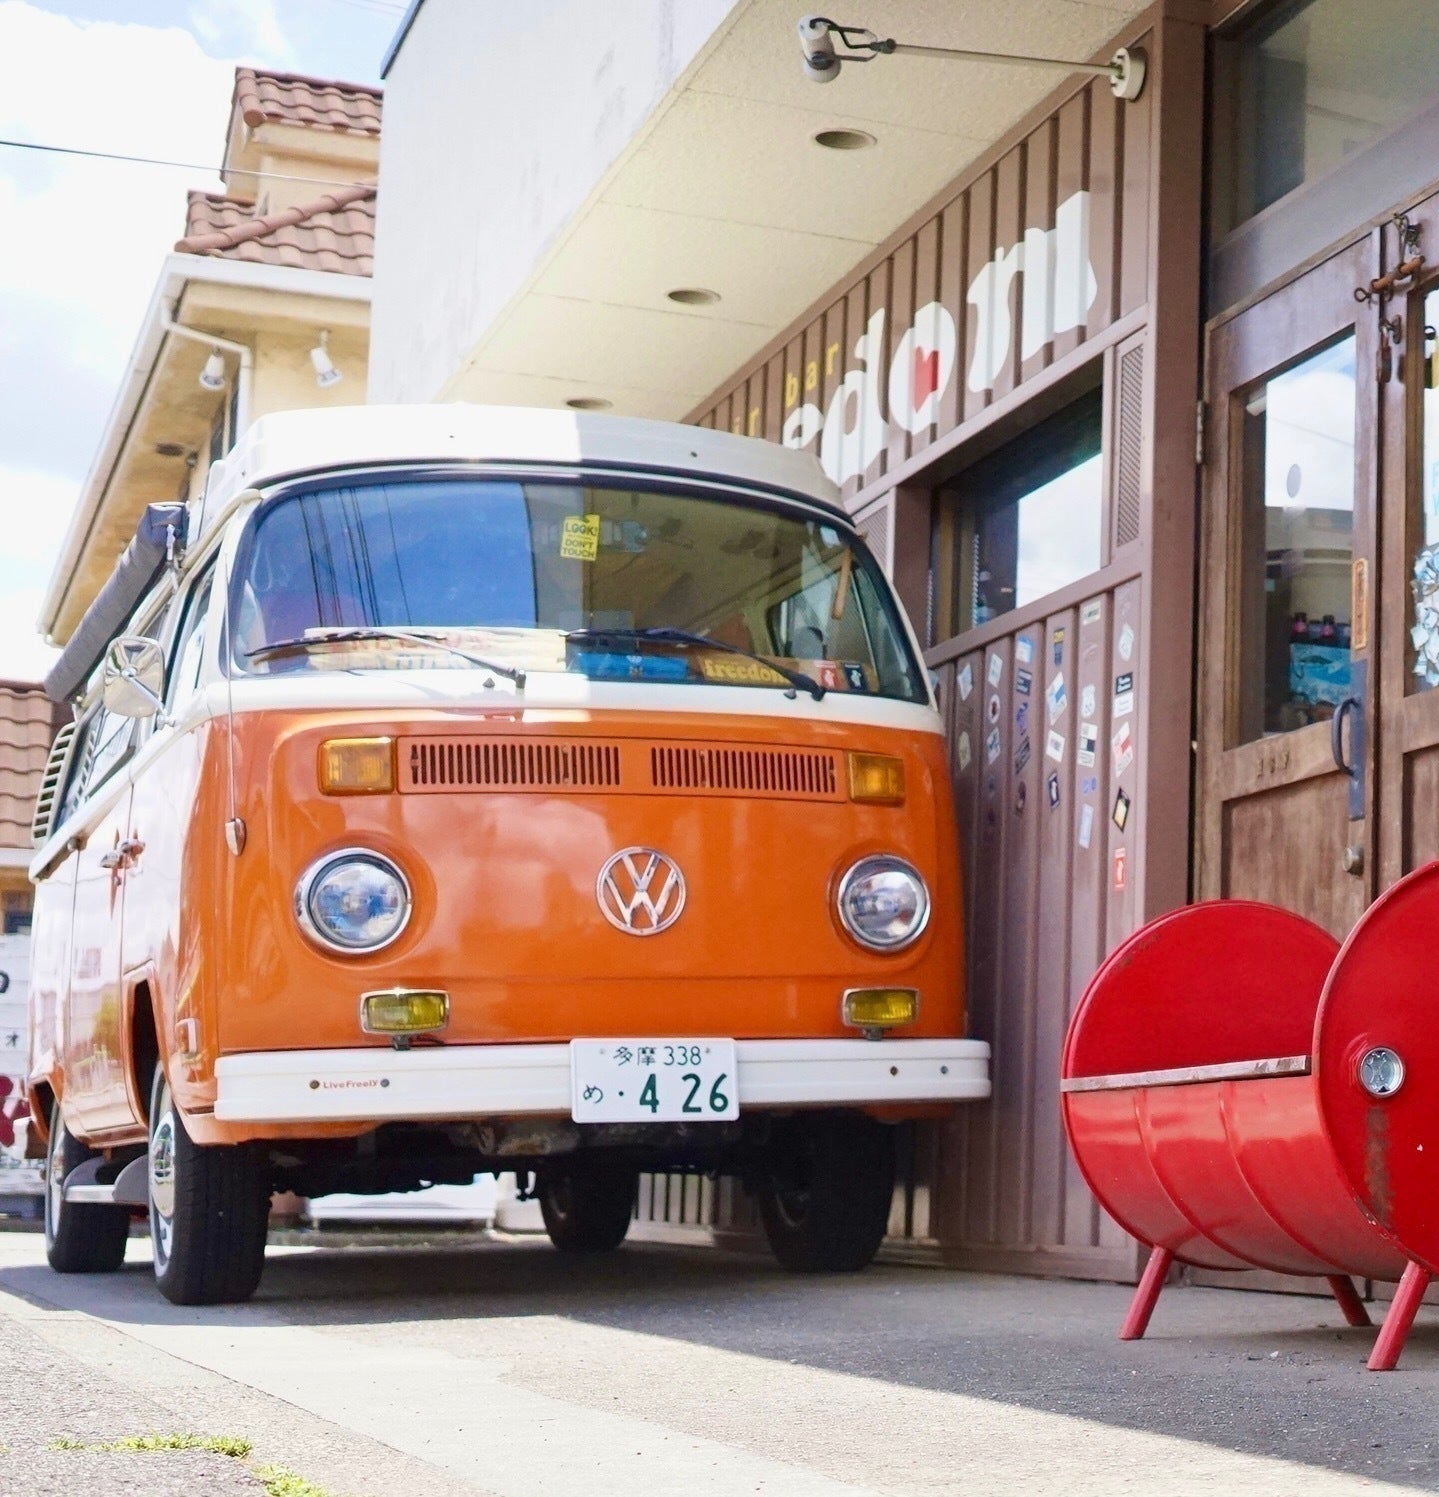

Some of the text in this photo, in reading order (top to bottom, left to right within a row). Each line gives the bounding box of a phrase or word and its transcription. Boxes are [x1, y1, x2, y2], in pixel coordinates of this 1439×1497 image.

[783, 190, 1098, 487] edom
[784, 342, 840, 409] bar
[613, 1046, 702, 1066] 多摩 338
[583, 1084, 604, 1105] め
